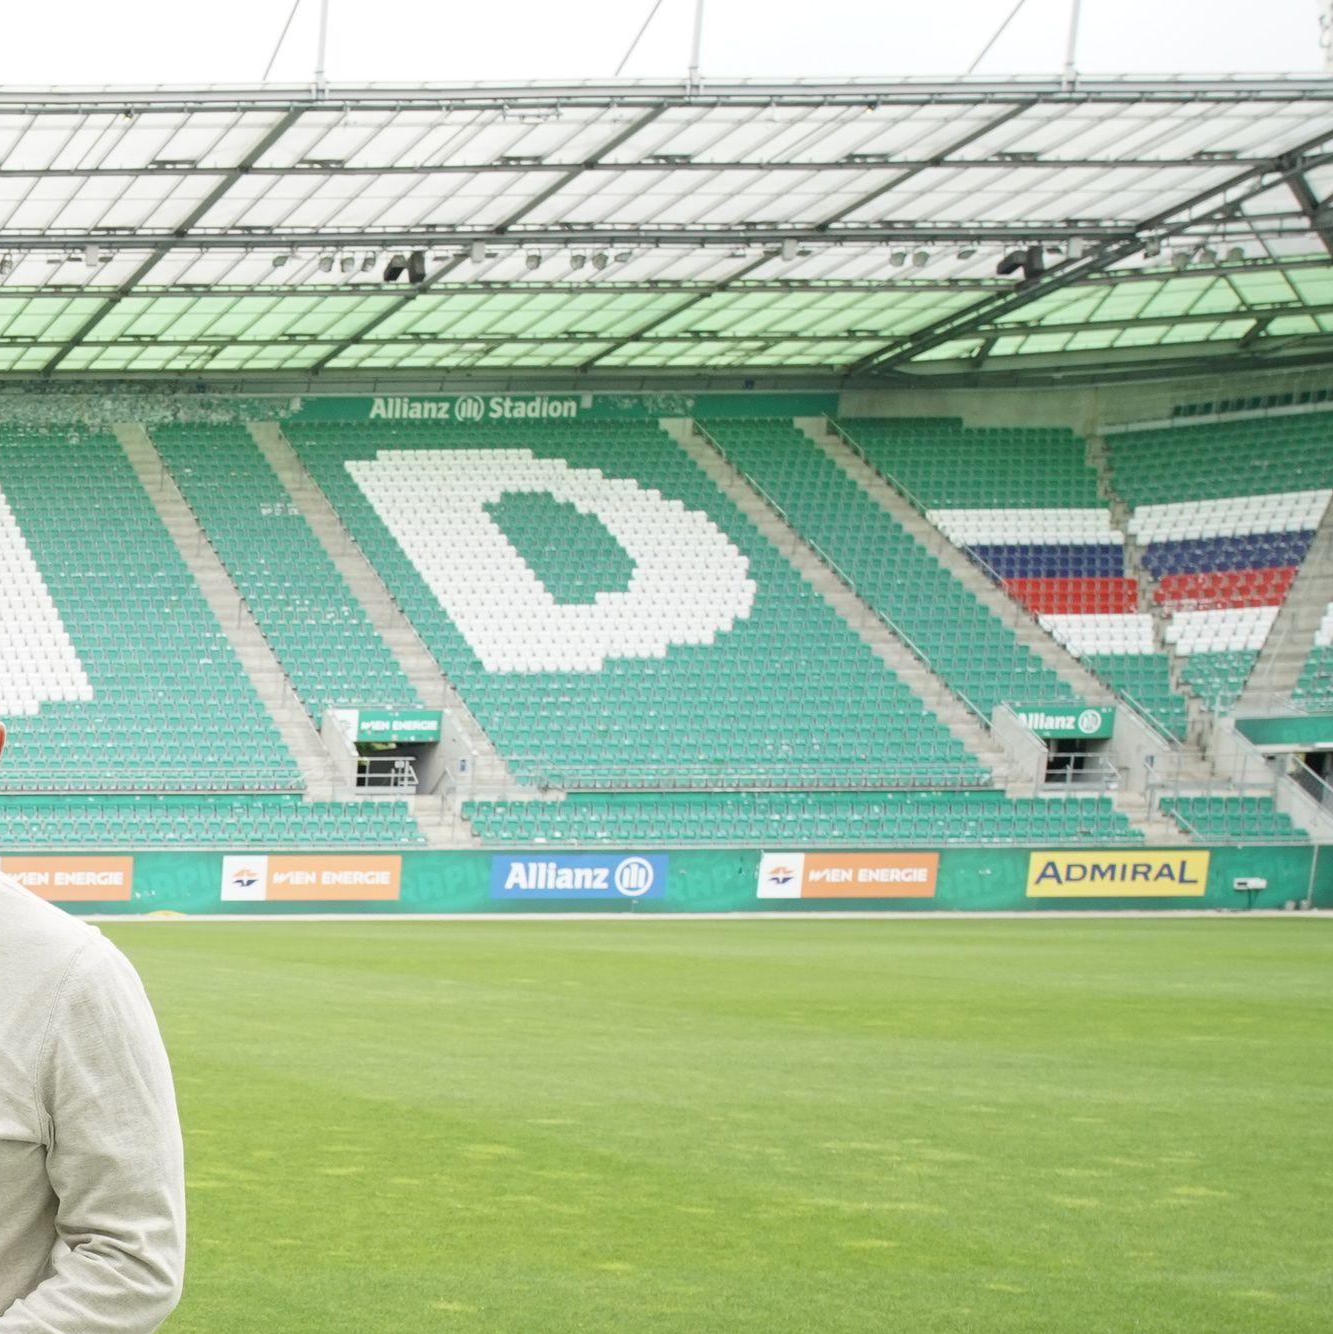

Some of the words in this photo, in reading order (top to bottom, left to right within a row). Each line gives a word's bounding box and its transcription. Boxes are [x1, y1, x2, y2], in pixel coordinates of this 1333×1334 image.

[369, 397, 449, 418] Allianz
[489, 396, 577, 418] Stadion
[1018, 712, 1076, 730] Allianz
[54, 872, 124, 885] ENERGIE
[273, 871, 316, 885] WIEN
[321, 871, 390, 885] ENERGIE
[504, 862, 609, 889] Allianz
[809, 868, 852, 883] WIEN
[858, 868, 928, 883] ENERGIE
[1035, 859, 1199, 886] ADMIRAL
